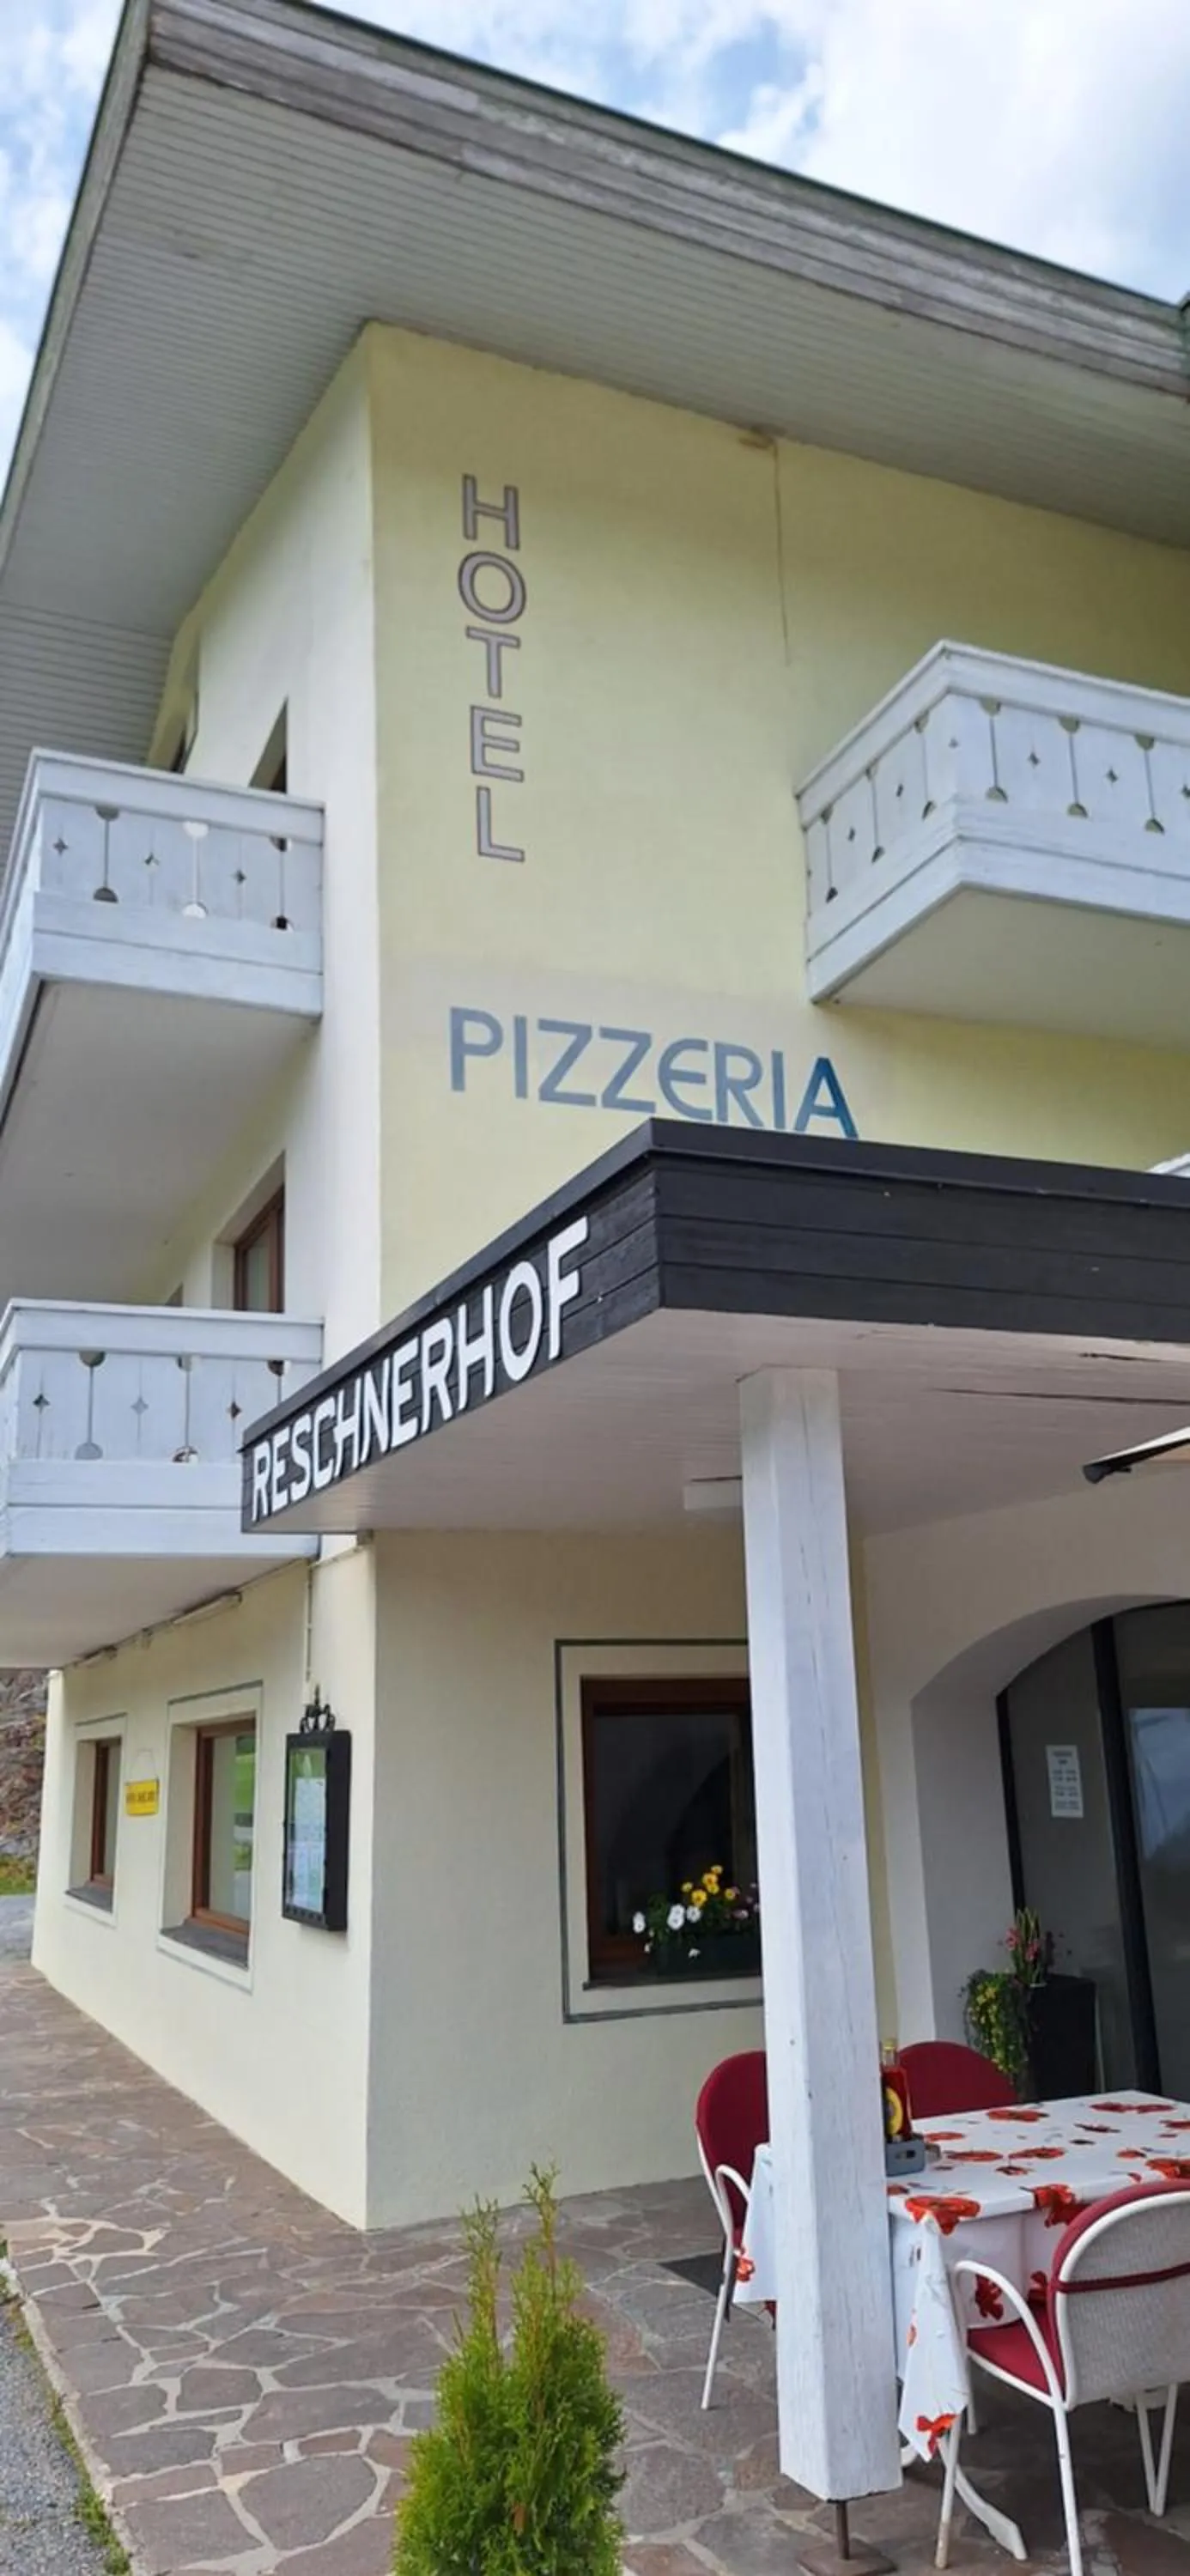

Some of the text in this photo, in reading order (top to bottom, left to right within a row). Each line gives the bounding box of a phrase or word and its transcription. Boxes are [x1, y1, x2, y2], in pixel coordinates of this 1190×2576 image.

[458, 473, 526, 862] HOTEL
[450, 1006, 859, 1139] PIZZERIA
[252, 1216, 588, 1522] RESCHNERHOF
